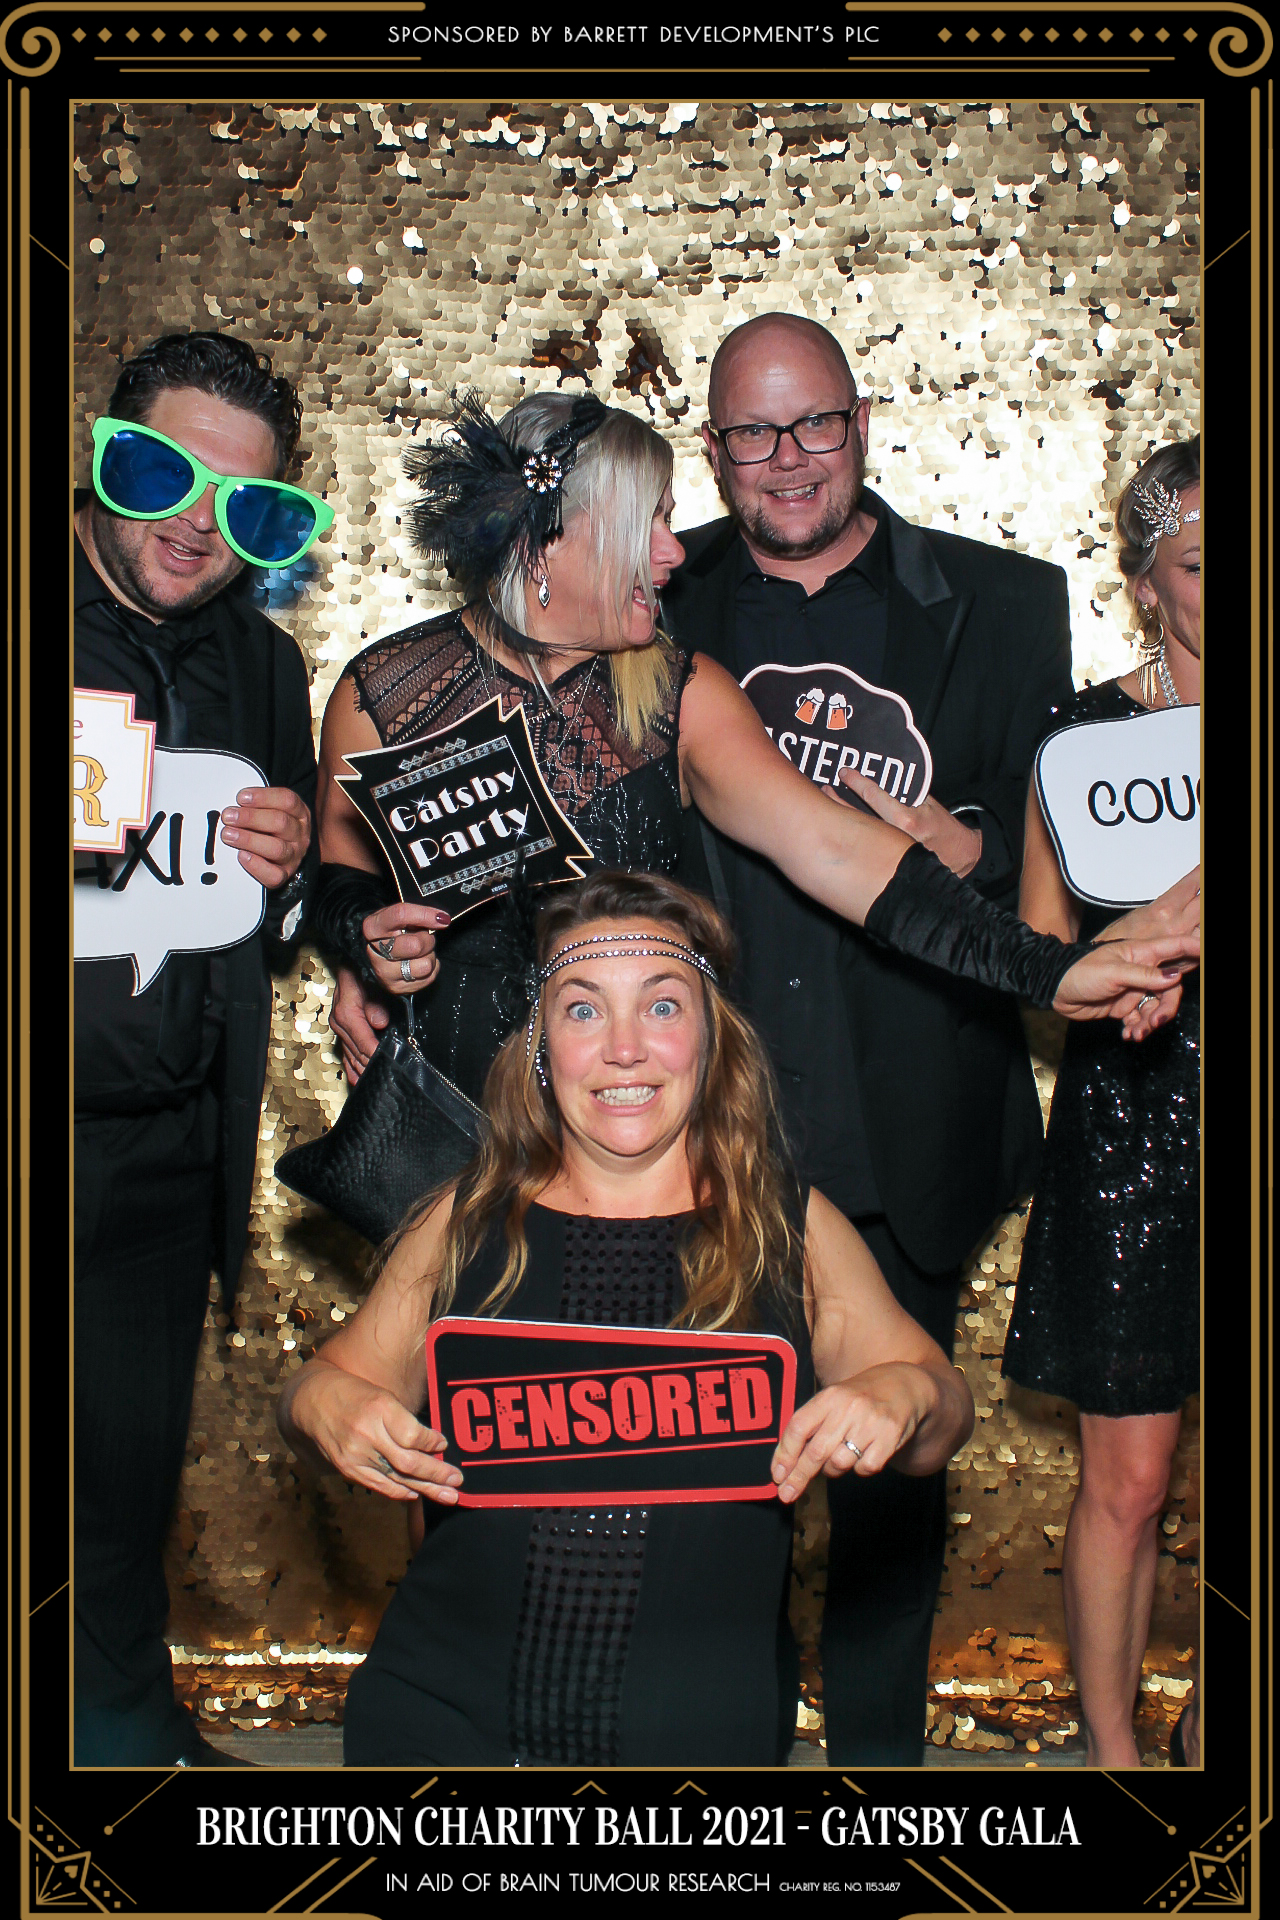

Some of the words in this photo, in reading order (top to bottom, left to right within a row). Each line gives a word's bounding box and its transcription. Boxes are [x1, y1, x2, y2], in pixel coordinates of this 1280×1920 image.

[765, 726, 917, 804] STERED!
[389, 766, 516, 833] Gatsby
[1087, 774, 1200, 827] COU
[407, 803, 530, 870] Party
[451, 1367, 774, 1453] CENSORED
